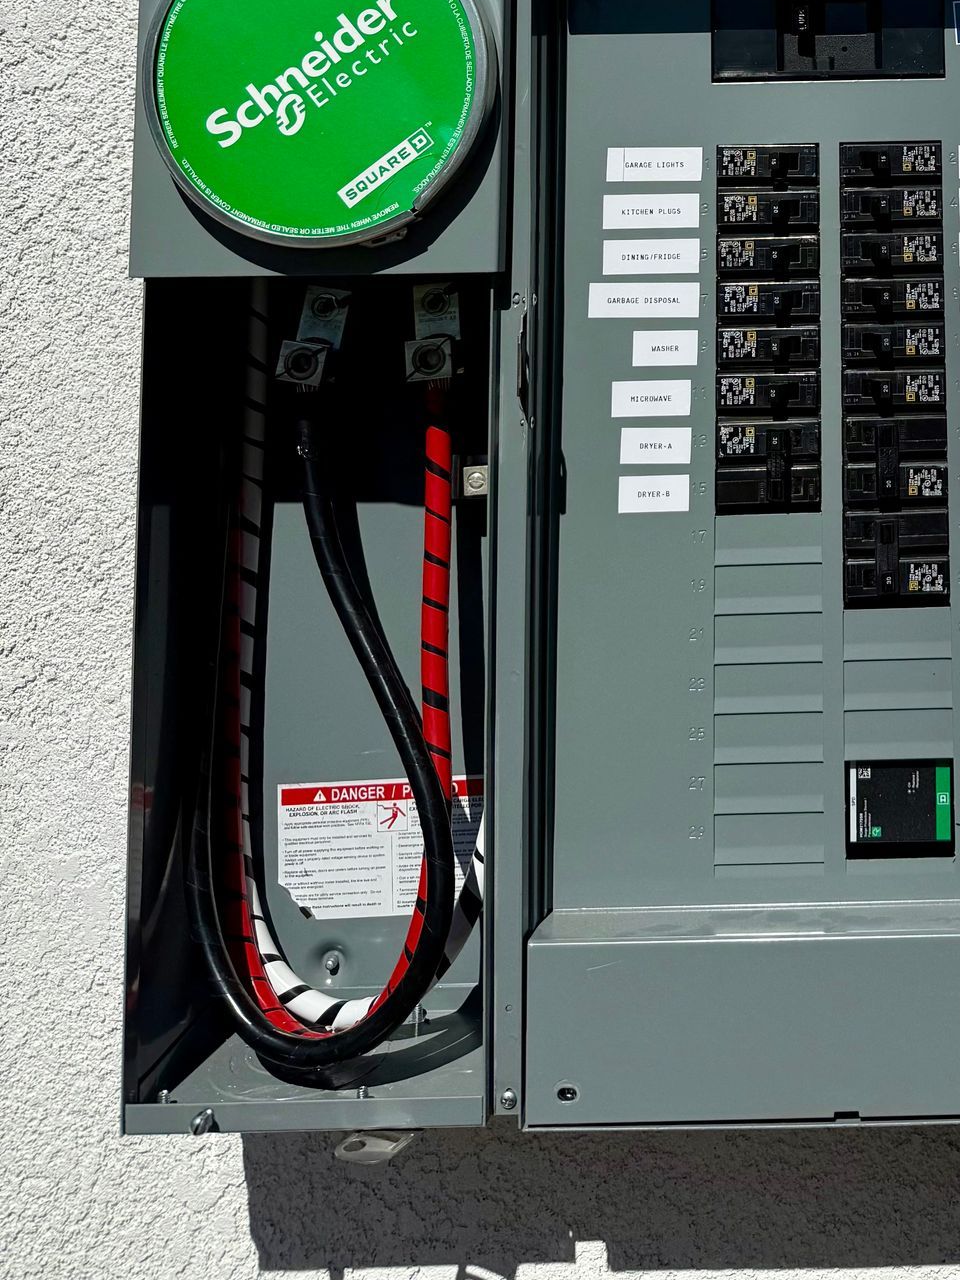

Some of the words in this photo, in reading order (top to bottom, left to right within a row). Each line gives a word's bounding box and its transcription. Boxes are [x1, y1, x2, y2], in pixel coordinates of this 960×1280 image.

[163, 1, 184, 42] WATTMÈTRE
[452, 8, 461, 18] LA
[456, 17, 470, 50] CUBIERTA
[160, 42, 168, 52] LE
[464, 50, 472, 60] DE
[158, 52, 166, 78] QUAND
[307, 21, 418, 108] Electric
[157, 78, 168, 120] SEULEMENT
[452, 92, 471, 140] PERMANENTE
[164, 119, 179, 149] RETIRER
[345, 147, 412, 200] SQUARE
[412, 134, 427, 150] D
[204, 187, 212, 196] IS
[210, 192, 231, 211] COVER
[230, 208, 270, 229] PERMANENT
[371, 201, 399, 221] REMOVE
[270, 224, 298, 234] SEALED
[311, 226, 335, 234] METER
[336, 224, 350, 232] THE
[350, 216, 372, 228] WHEN
[630, 395, 672, 403] MICROWAVE
[637, 490, 671, 498] DRYER-B
[331, 786, 385, 801] DANGER
